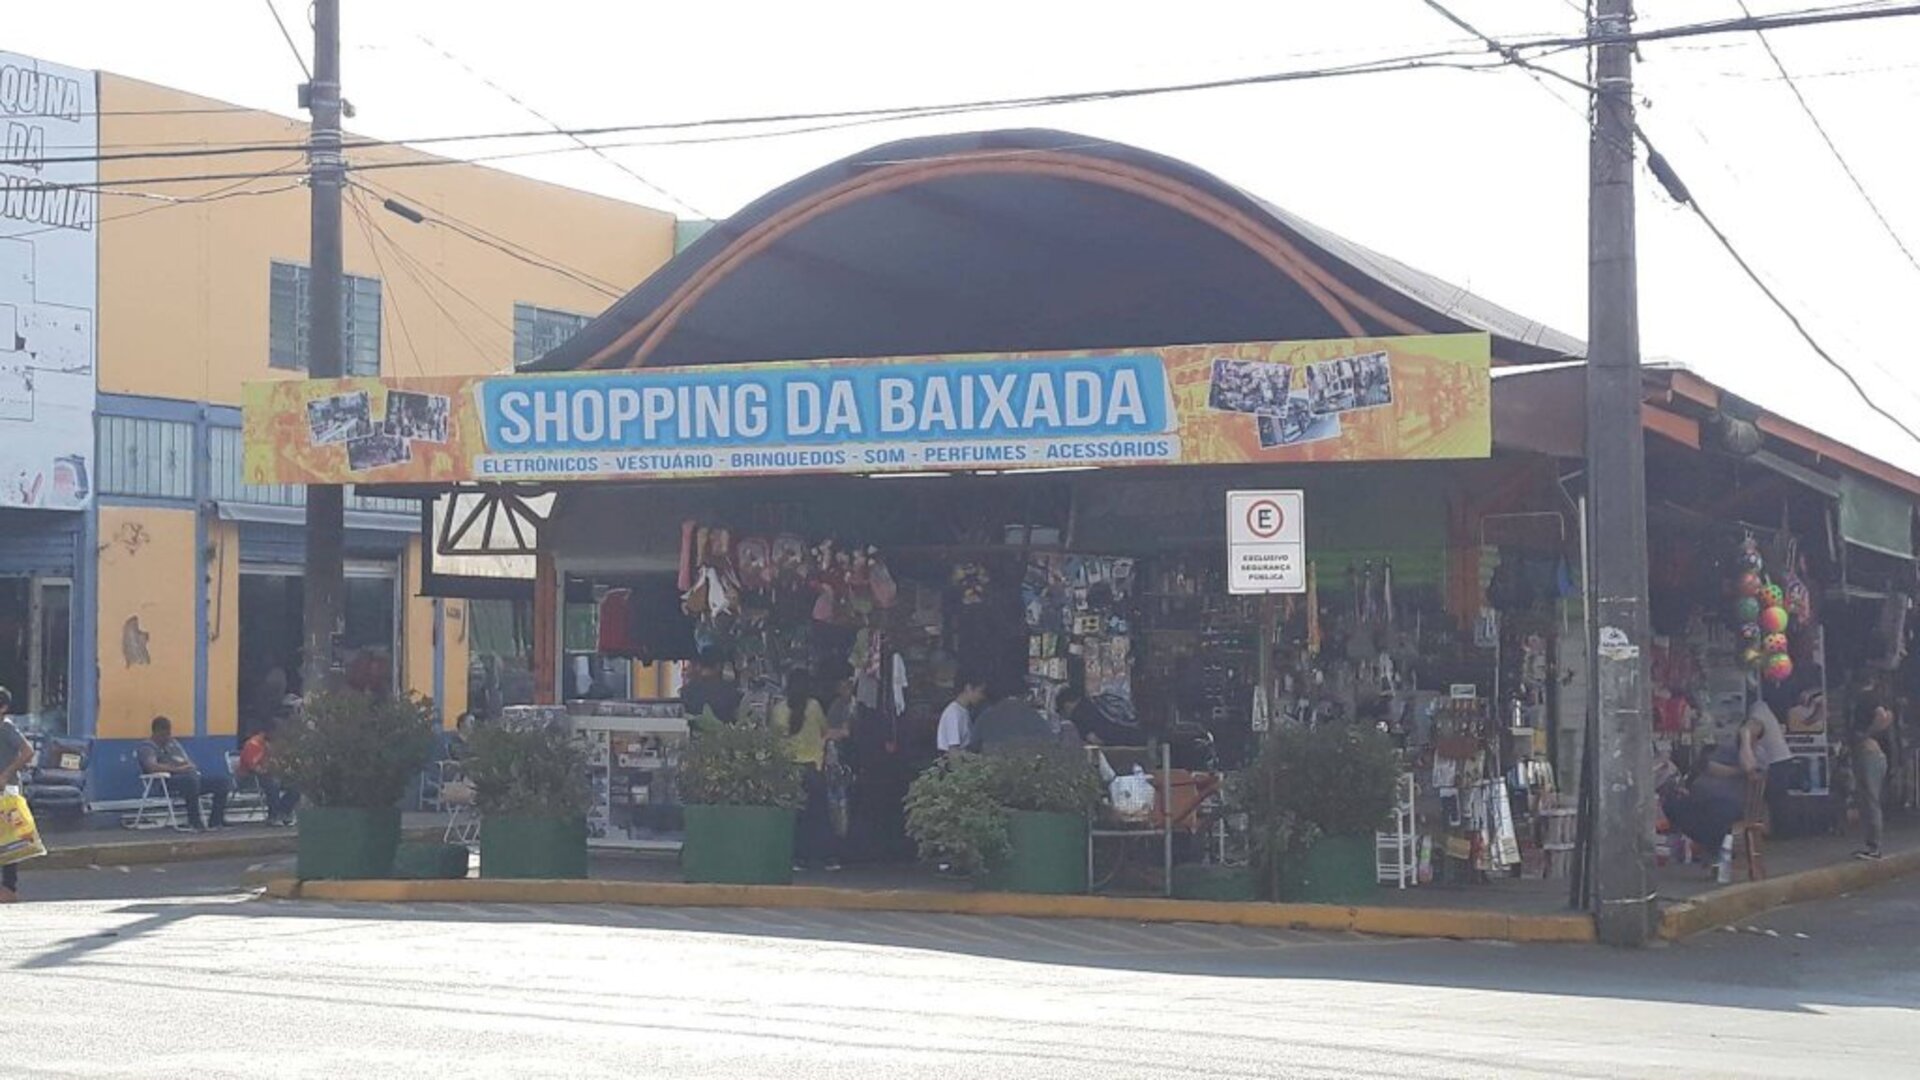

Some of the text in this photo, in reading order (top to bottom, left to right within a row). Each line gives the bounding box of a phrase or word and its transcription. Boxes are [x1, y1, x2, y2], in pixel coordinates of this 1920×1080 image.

[6, 122, 44, 170] DA
[500, 368, 1147, 444] SHOPPING DA BAIXADA
[483, 456, 599, 474] ELETRÔNICOS
[616, 452, 713, 470] VESTUÁRIO
[731, 449, 846, 468] BRINQUEDOS
[864, 448, 905, 464] SOM
[925, 444, 1026, 462] PERFUMES
[1047, 440, 1169, 459] ACESSÓRIOS
[1258, 509, 1272, 528] E
[1241, 564, 1291, 572] SEGURANÇA
